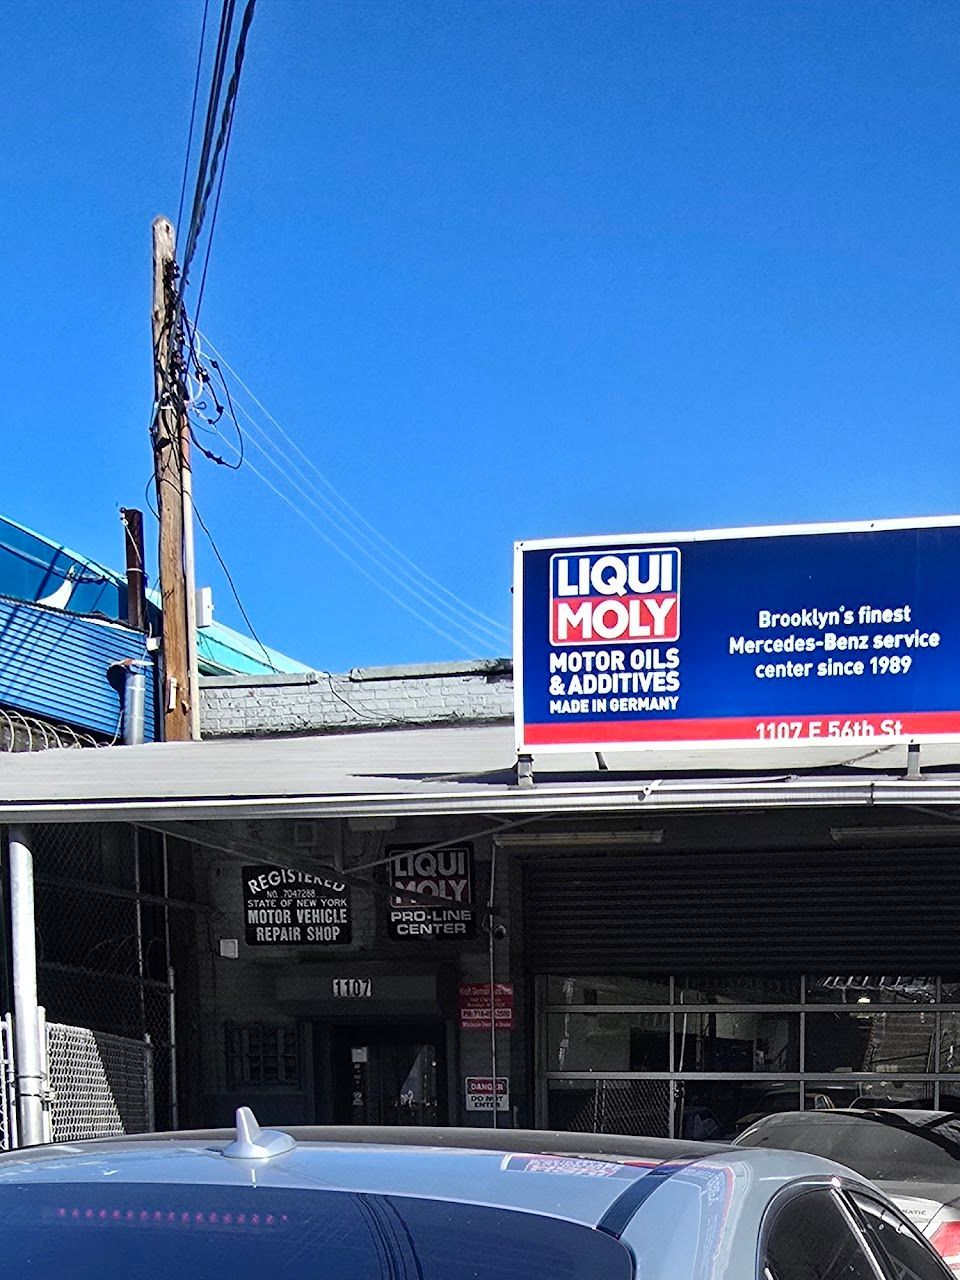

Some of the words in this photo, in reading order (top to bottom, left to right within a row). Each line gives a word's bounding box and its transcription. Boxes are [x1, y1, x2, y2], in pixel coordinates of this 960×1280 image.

[557, 553, 673, 597] LIQUI
[557, 597, 678, 640] MOLY
[758, 605, 855, 630] Brooklyn's
[858, 604, 912, 625] finest
[728, 631, 870, 655] Mercedes-Benz
[872, 629, 941, 650] service
[549, 650, 626, 674] MOTOR
[629, 646, 681, 671] OILS
[754, 659, 814, 679] center
[816, 658, 865, 677] since
[868, 654, 913, 675] 1989
[549, 697, 589, 715] MADE
[591, 697, 607, 714] IN
[608, 695, 680, 713] GERMANY
[755, 720, 803, 740] 1107
[879, 718, 907, 736] St
[393, 850, 466, 878] LIQUI
[246, 899, 277, 908] STATE
[279, 899, 294, 908] OF
[296, 898, 318, 908] NEW
[320, 897, 348, 907] YORK
[247, 909, 292, 924] MOTOR
[296, 908, 349, 924] VEHICLE
[390, 909, 473, 923] PRO-LINE
[255, 926, 302, 942] REPAIR
[306, 925, 341, 941] SHOP
[396, 922, 467, 936] CENTER
[333, 978, 373, 998] 1107
[470, 1082, 505, 1092] DANGR
